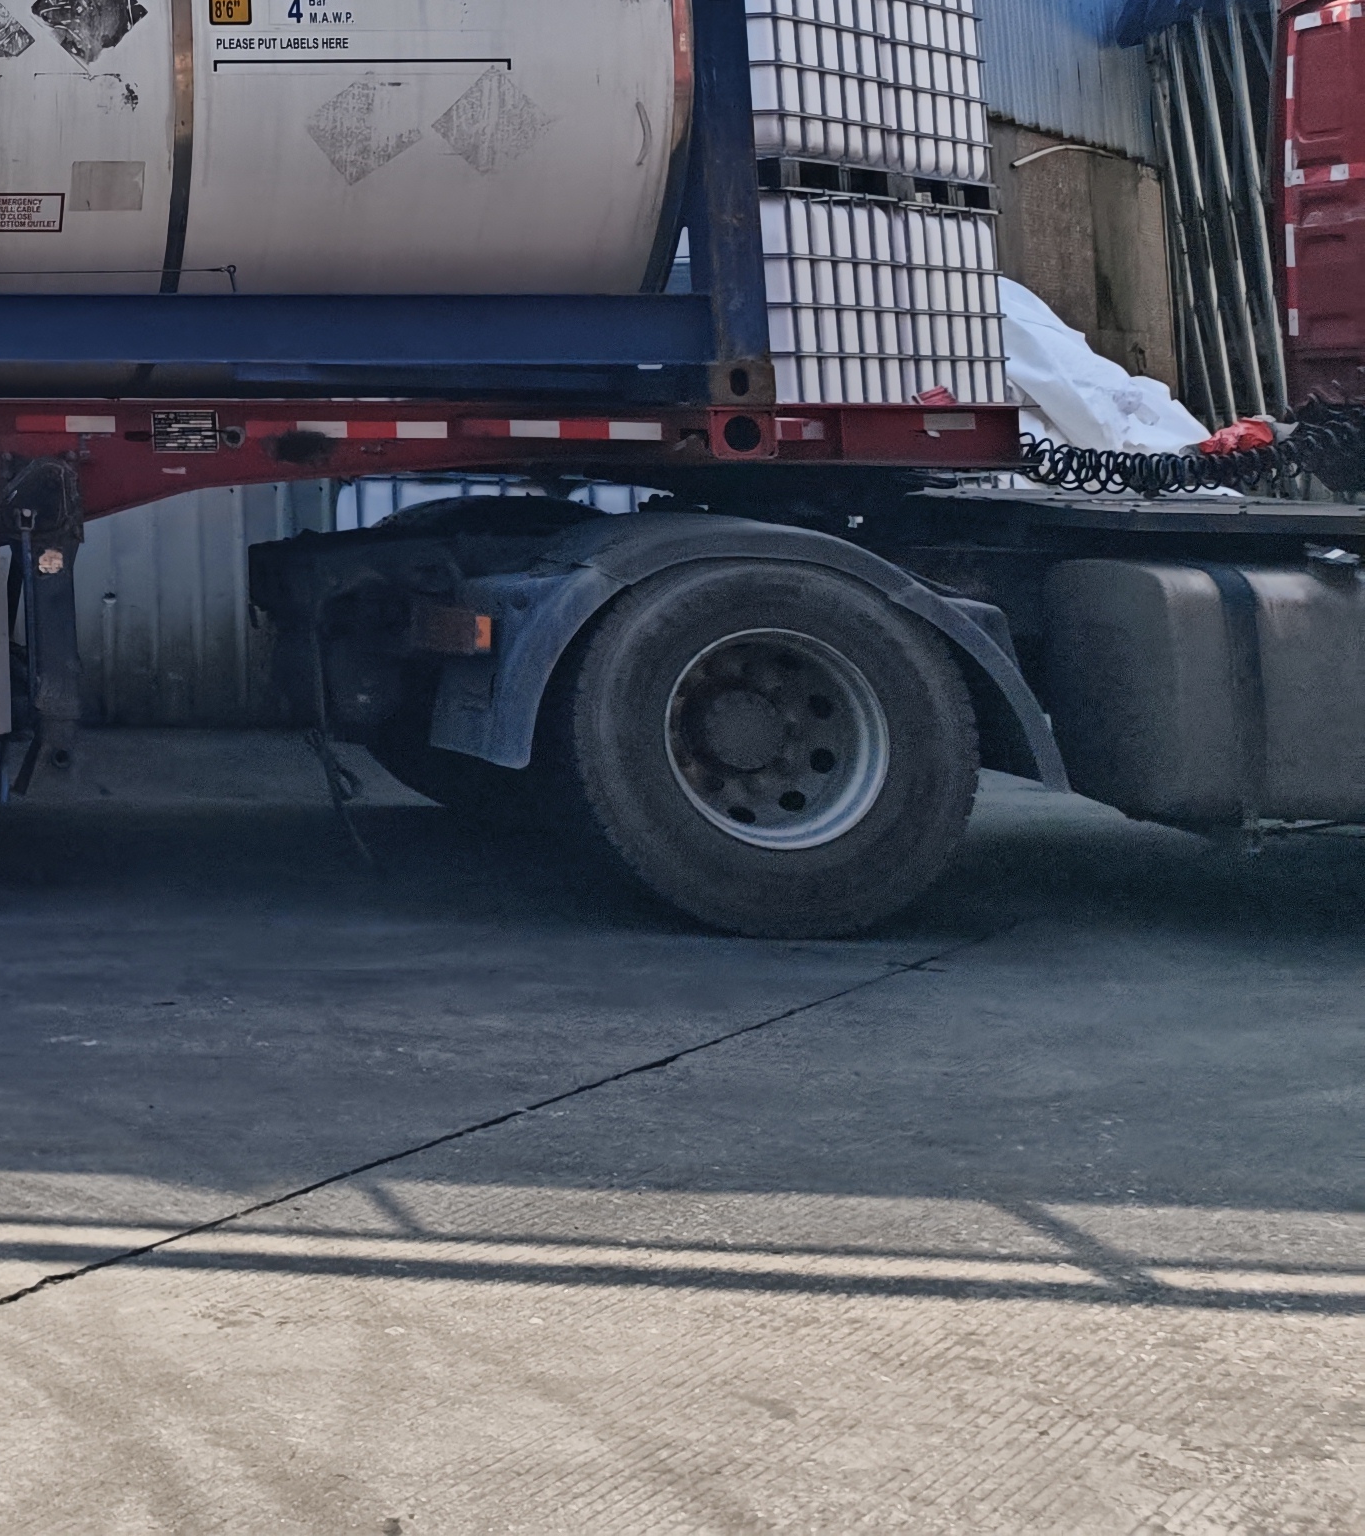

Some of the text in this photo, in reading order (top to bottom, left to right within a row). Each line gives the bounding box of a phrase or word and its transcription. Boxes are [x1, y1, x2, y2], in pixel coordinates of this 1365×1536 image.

[309, 12, 355, 24] M.A.W.P.
[216, 37, 349, 50] PLEASE PUT LABELS HERE
[27, 220, 56, 228] OUTLET
